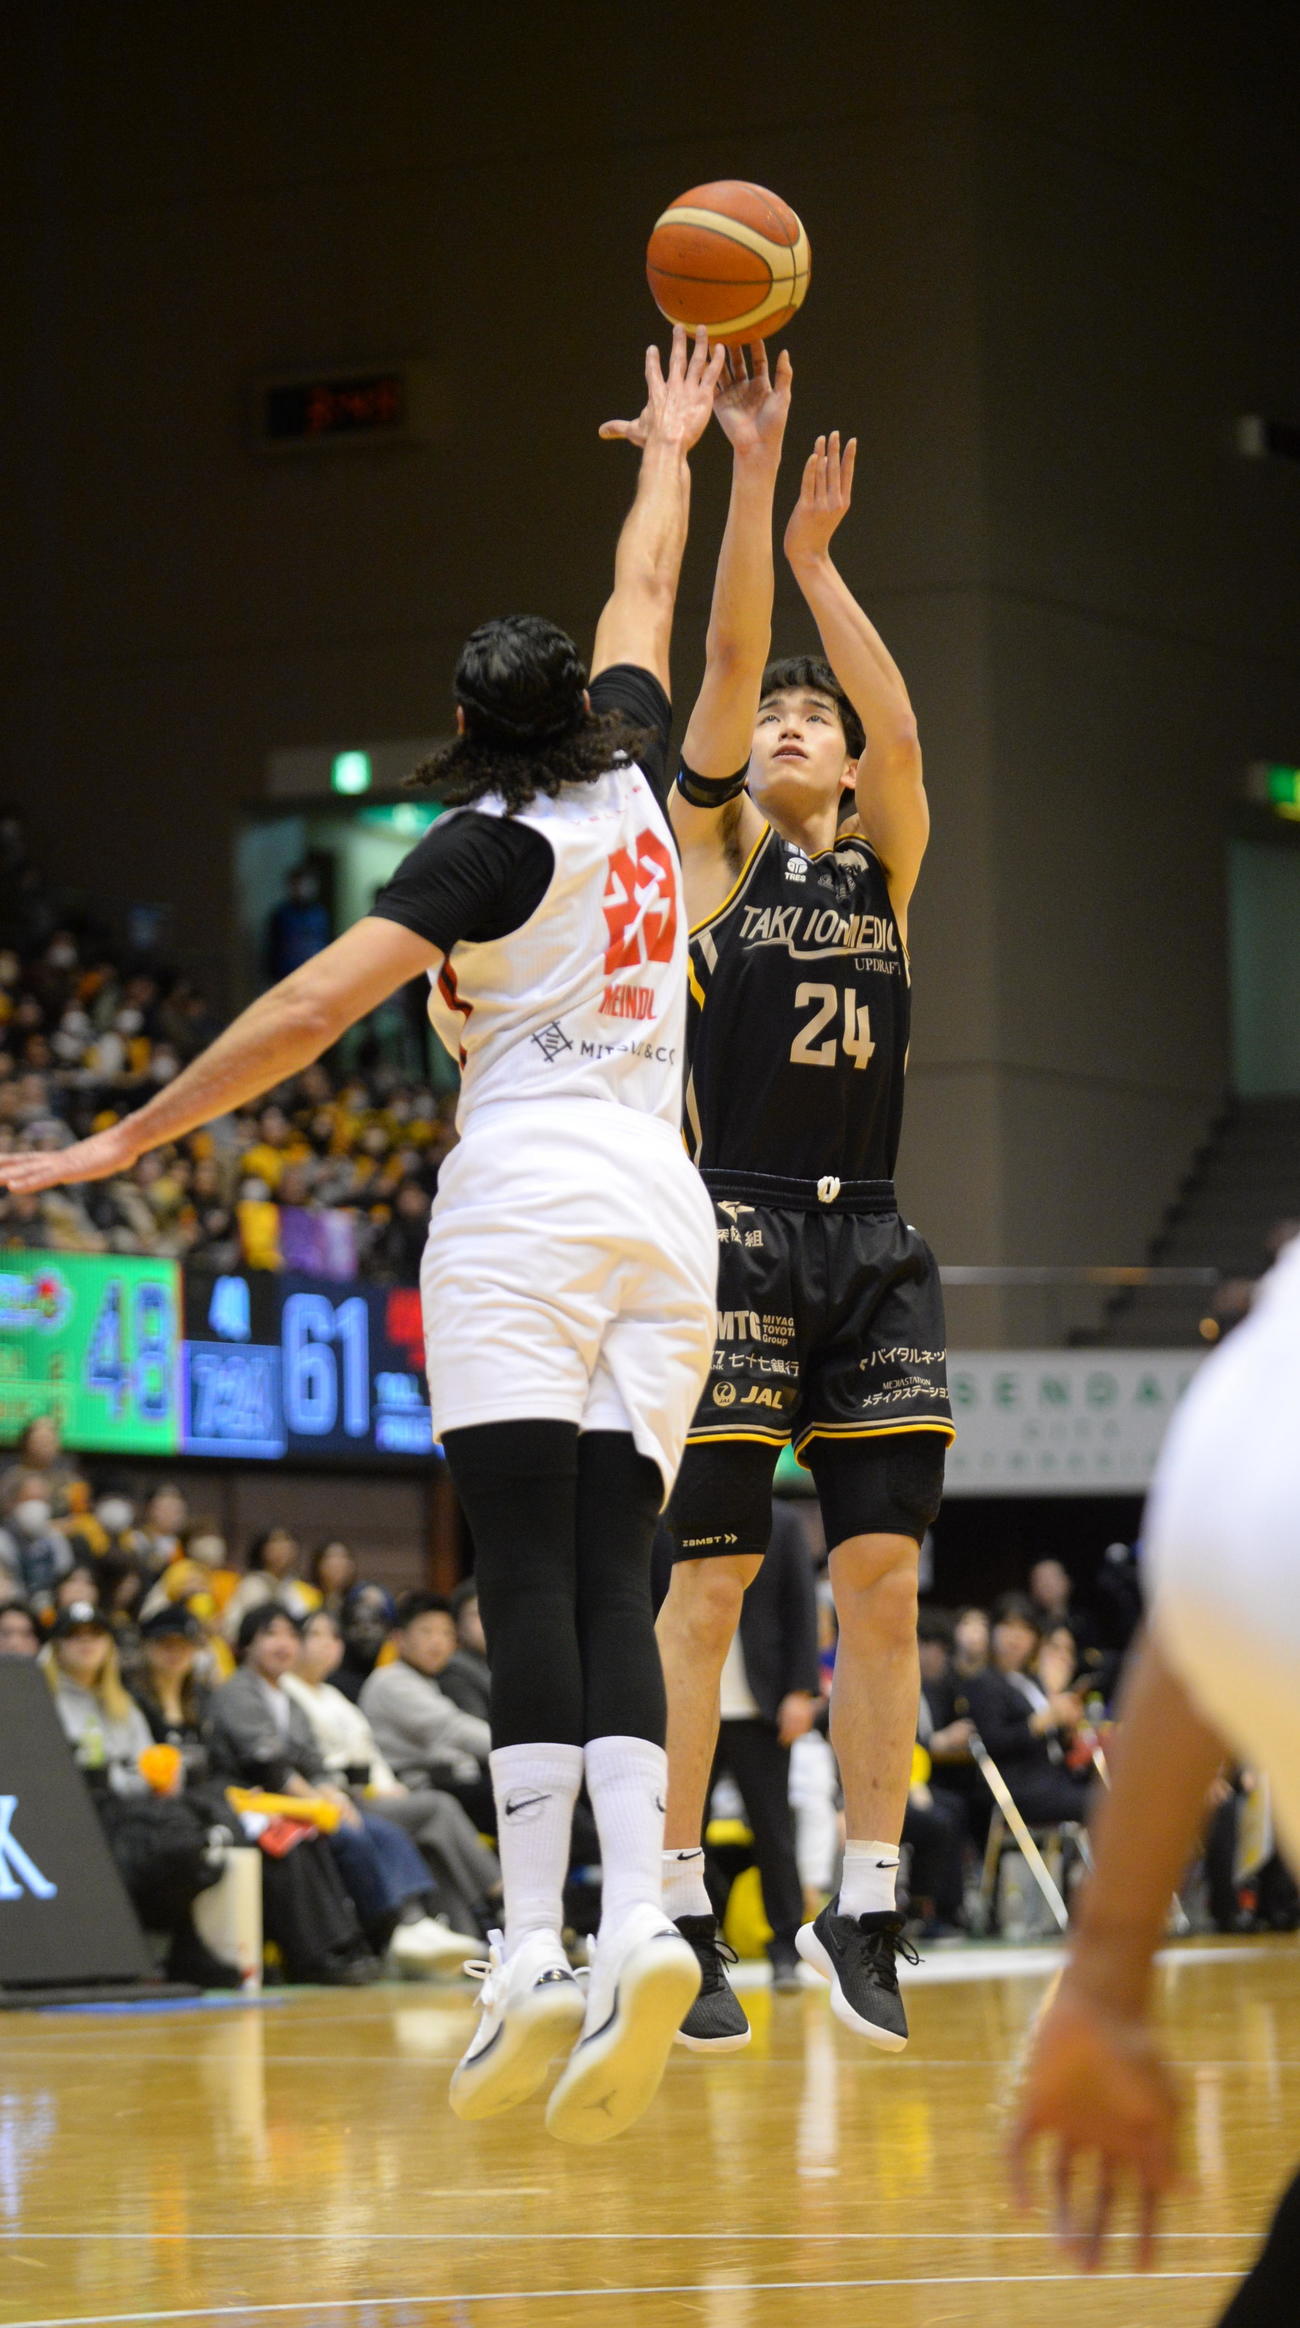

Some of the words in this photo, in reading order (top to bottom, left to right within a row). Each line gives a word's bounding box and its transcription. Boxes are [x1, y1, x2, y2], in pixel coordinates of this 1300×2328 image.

[784, 871, 806, 883] TRES
[789, 982, 876, 1070] 24
[717, 1310, 761, 1341] MTG
[82, 1276, 174, 1423] 48
[762, 1334, 789, 1347] Group
[282, 1293, 370, 1437] 61
[728, 1353, 799, 1377] 七十七銀行
[870, 1347, 947, 1367] バイタルネッ
[740, 1385, 783, 1410] JAL
